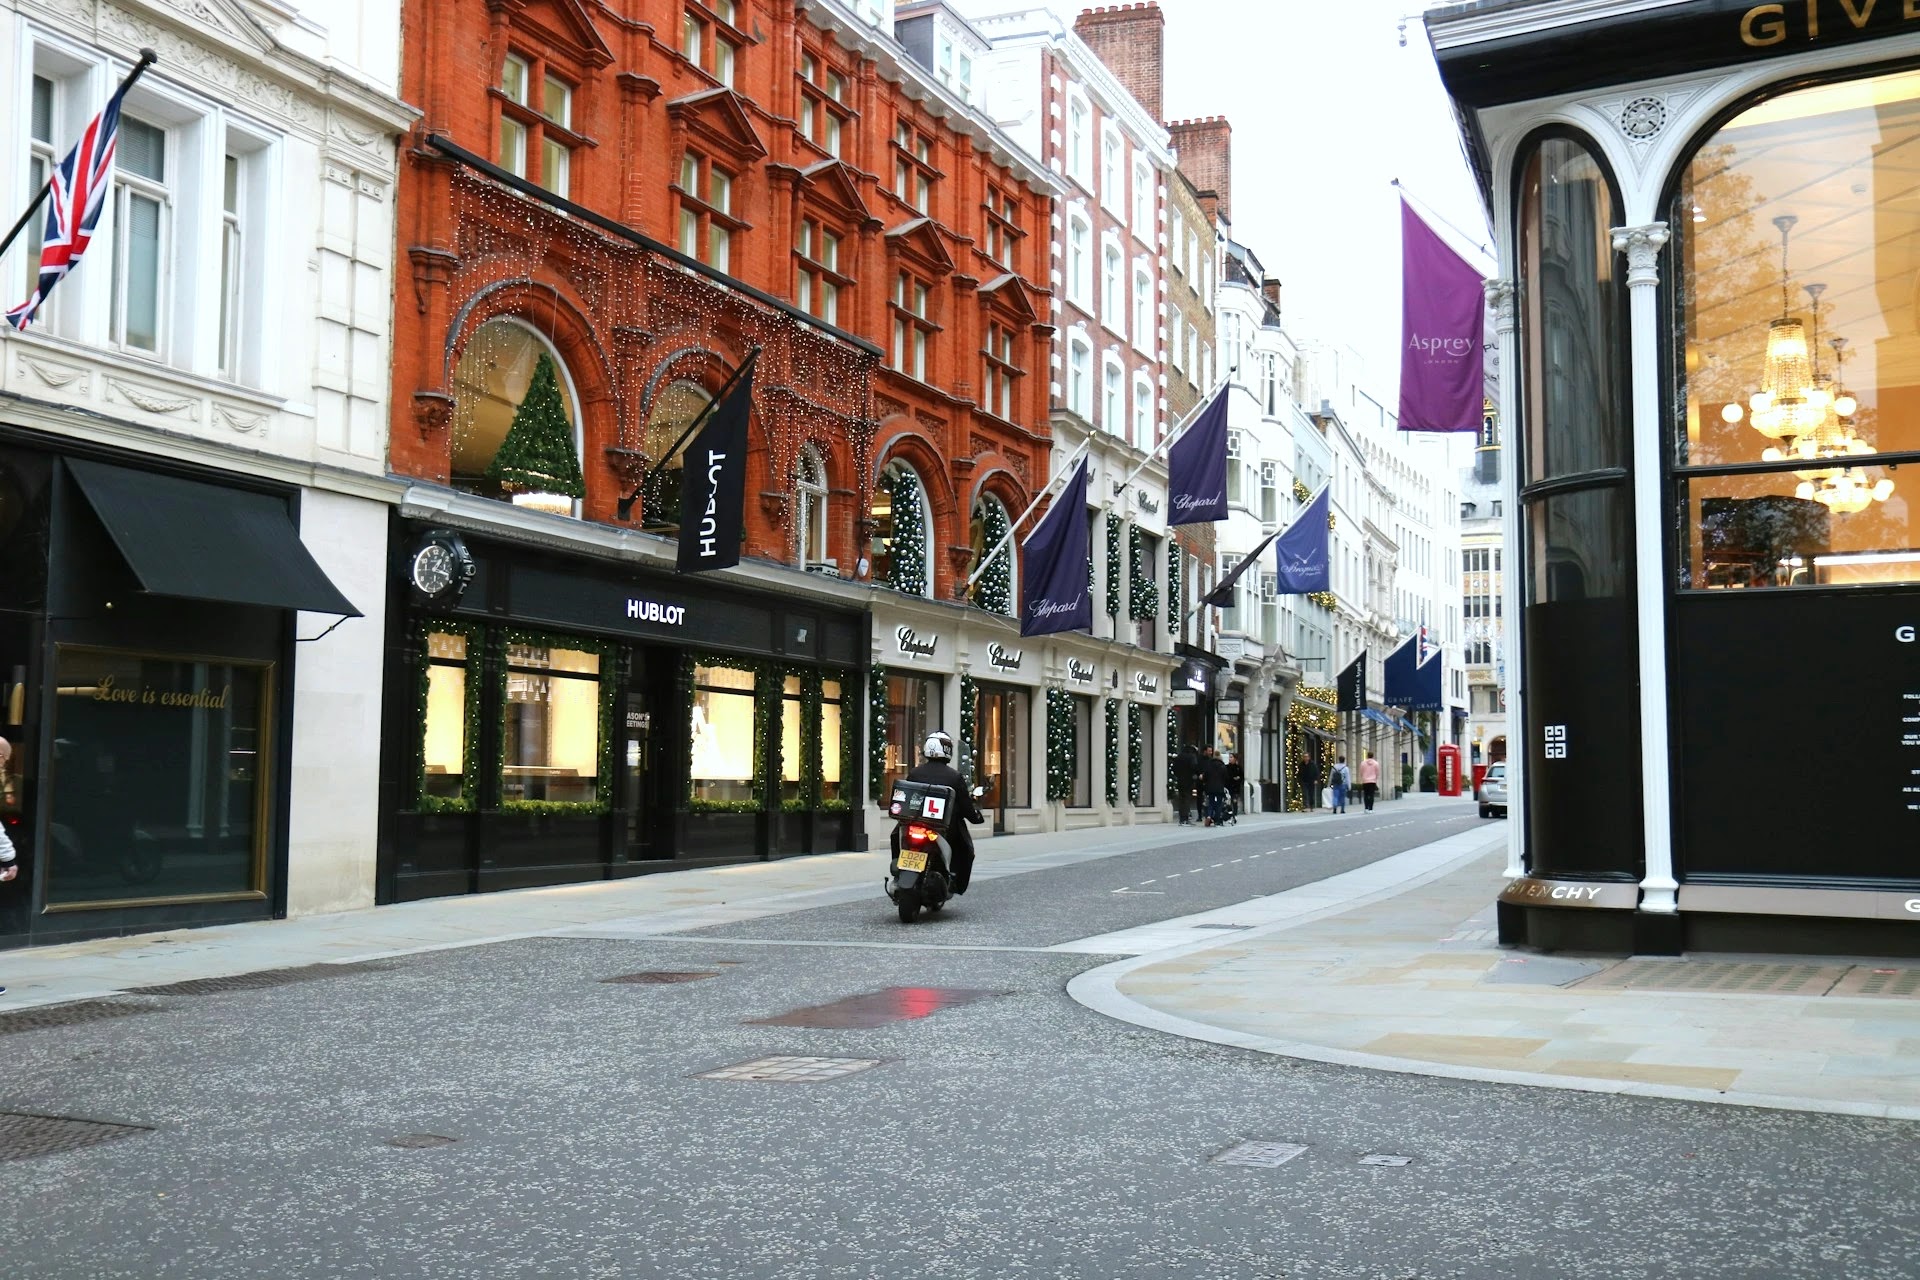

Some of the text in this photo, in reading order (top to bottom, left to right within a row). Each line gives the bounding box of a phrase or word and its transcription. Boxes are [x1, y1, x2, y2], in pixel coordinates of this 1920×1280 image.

[1408, 332, 1475, 356] Asprey
[1173, 491, 1221, 511] Chopard
[627, 599, 685, 625] HUBLOT
[1028, 592, 1081, 618] Chopard
[897, 625, 938, 659] Chopard
[1895, 626, 1916, 642] G
[94, 675, 230, 709] Love is essential
[928, 799, 939, 813] L
[902, 860, 921, 869] SFK
